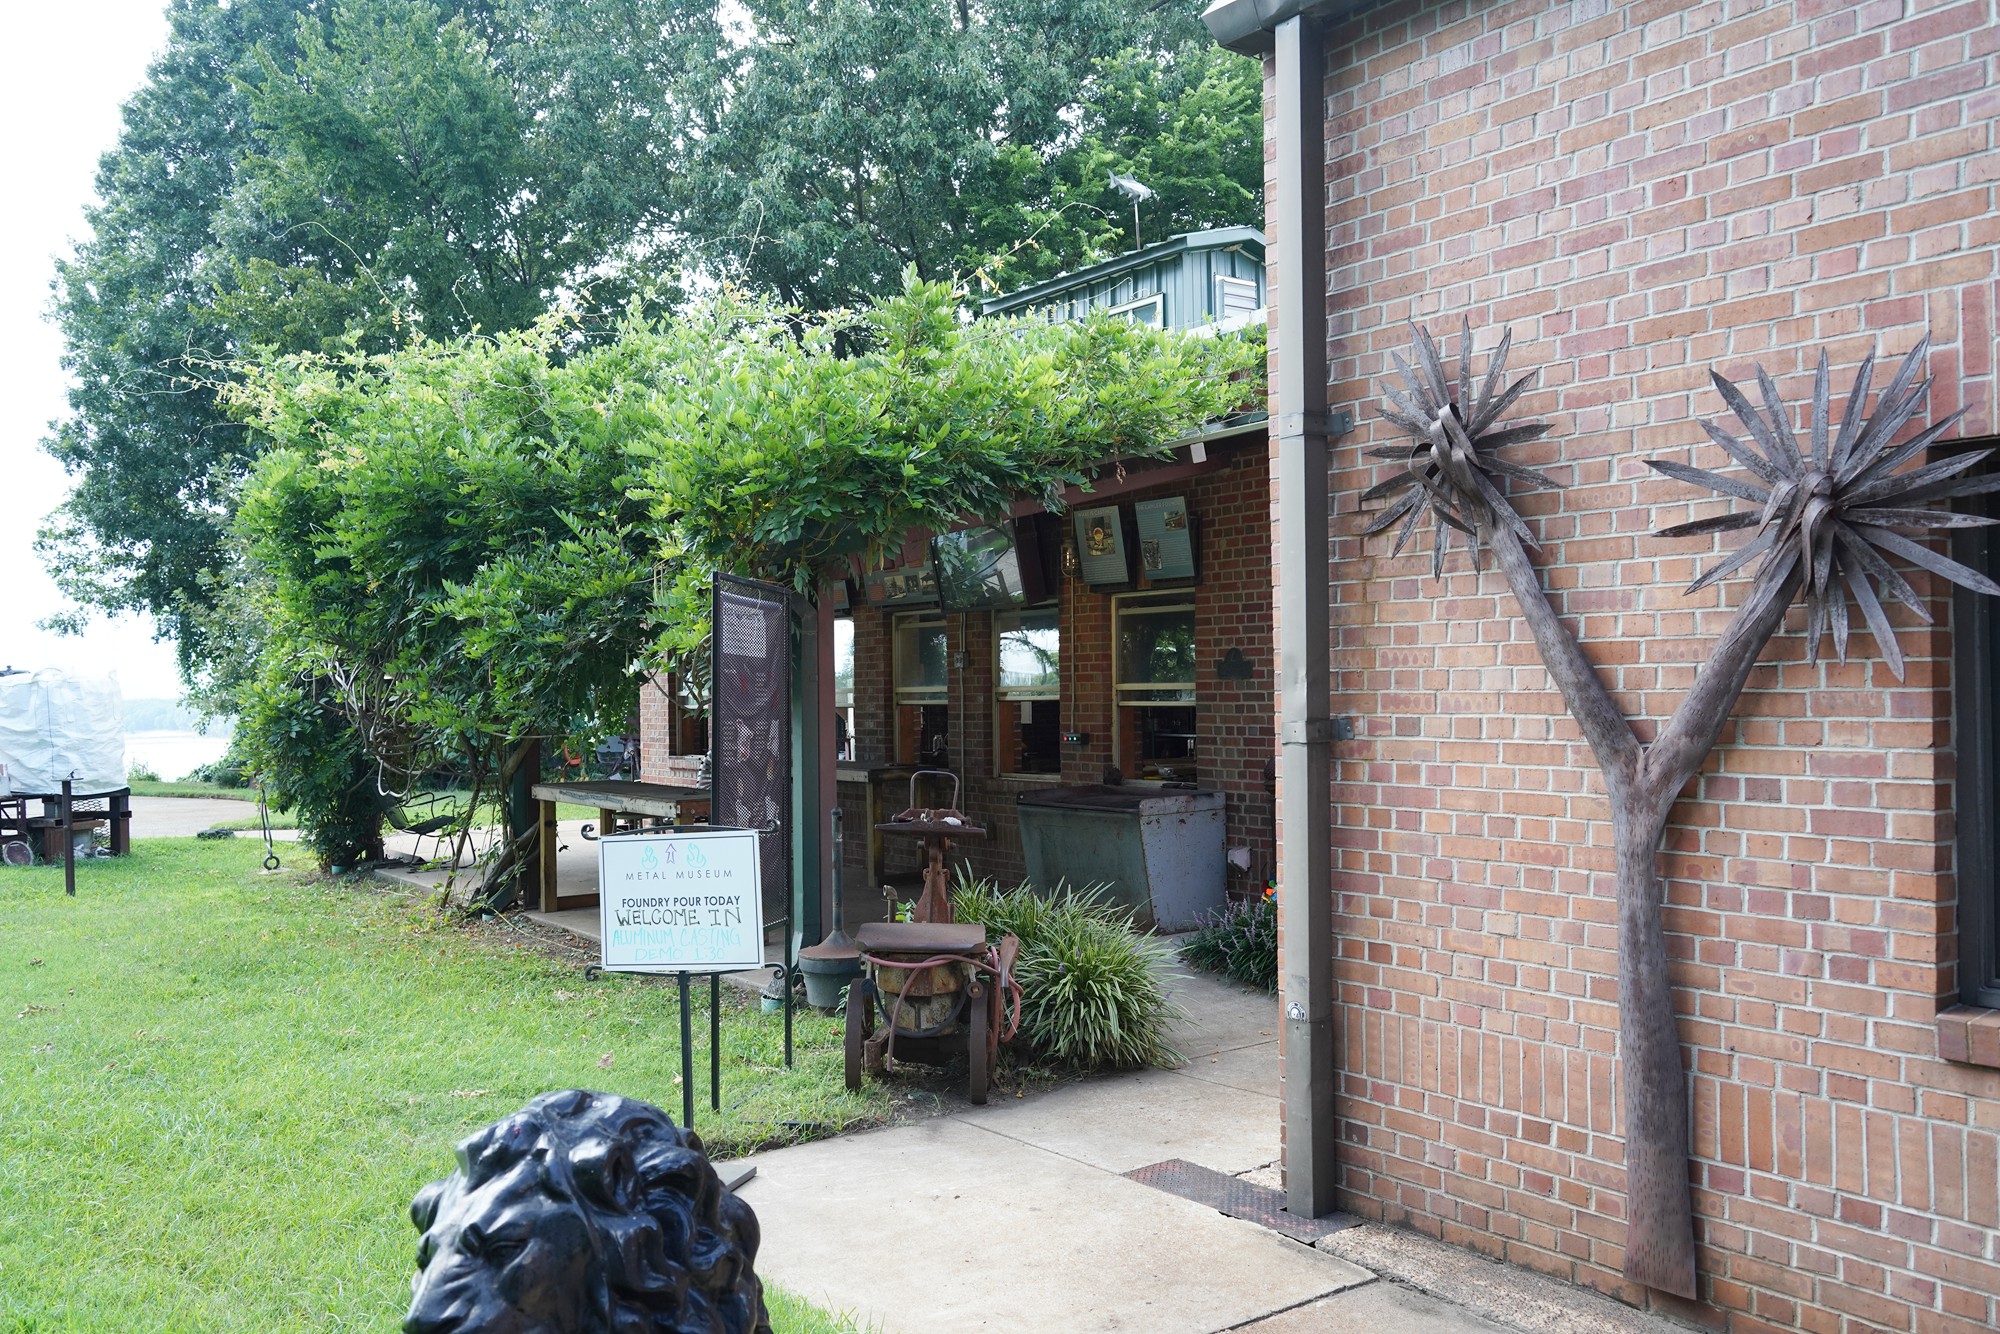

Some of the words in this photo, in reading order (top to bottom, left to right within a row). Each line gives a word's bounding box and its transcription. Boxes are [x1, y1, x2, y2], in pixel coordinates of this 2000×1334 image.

[625, 872, 667, 880] METAL
[676, 870, 732, 878] MUSEUM
[622, 898, 670, 908] FOUNDRY
[674, 897, 701, 906] POUR
[704, 896, 741, 906] TODAY
[614, 908, 700, 927] WELCOME
[708, 907, 742, 927] IN
[612, 928, 675, 948] ALUMINUM
[680, 927, 741, 947] CASTING
[634, 948, 683, 961] DEMO
